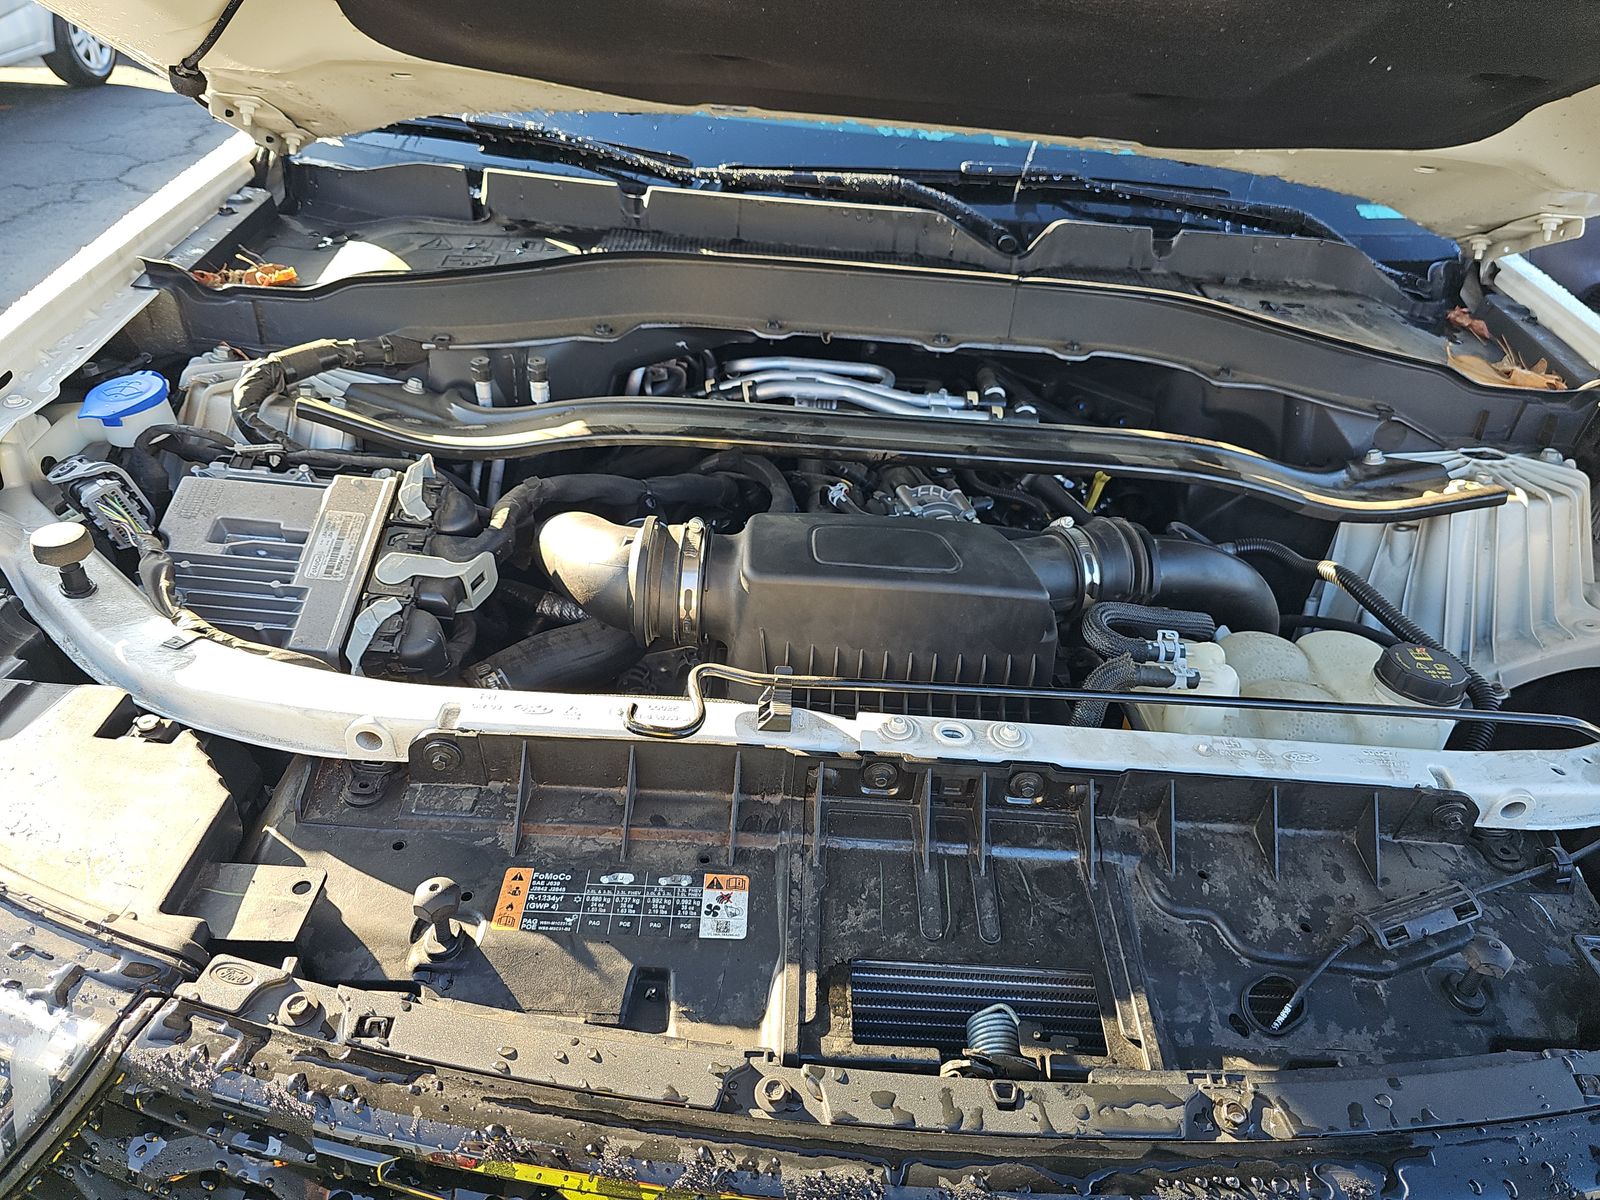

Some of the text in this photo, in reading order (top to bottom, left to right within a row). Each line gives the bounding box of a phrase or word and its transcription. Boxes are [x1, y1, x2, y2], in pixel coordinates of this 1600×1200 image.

[533, 872, 572, 880] FoMoCo
[528, 894, 564, 903] R-1234yf
[551, 903, 559, 911] 4)
